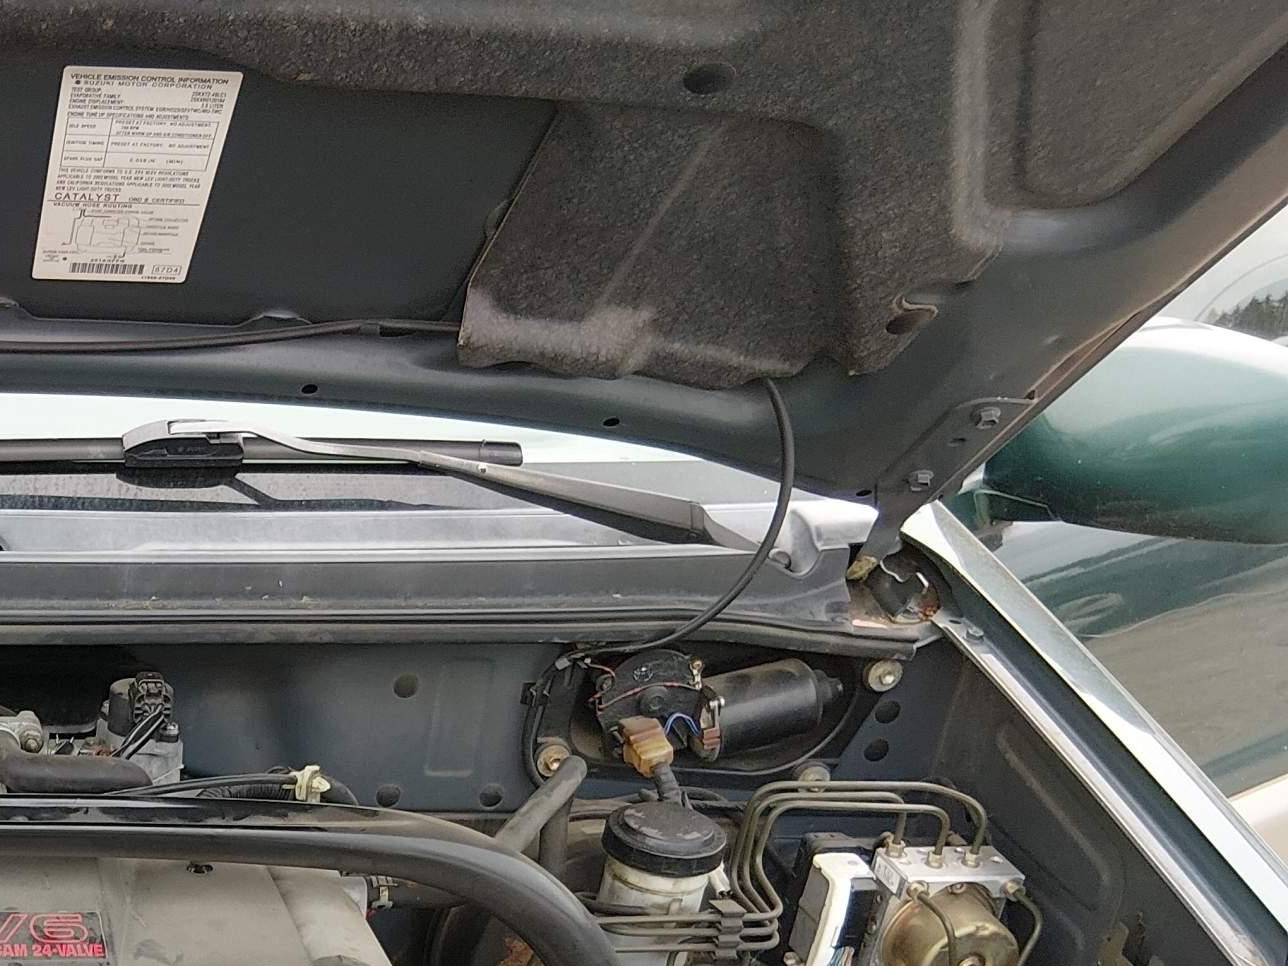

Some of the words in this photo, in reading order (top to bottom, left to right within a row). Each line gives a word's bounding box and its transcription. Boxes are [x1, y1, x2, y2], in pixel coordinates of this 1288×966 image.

[177, 77, 229, 85] INFORMATION
[54, 192, 120, 201] CATALYST
[31, 943, 105, 958] 24-VALVE
